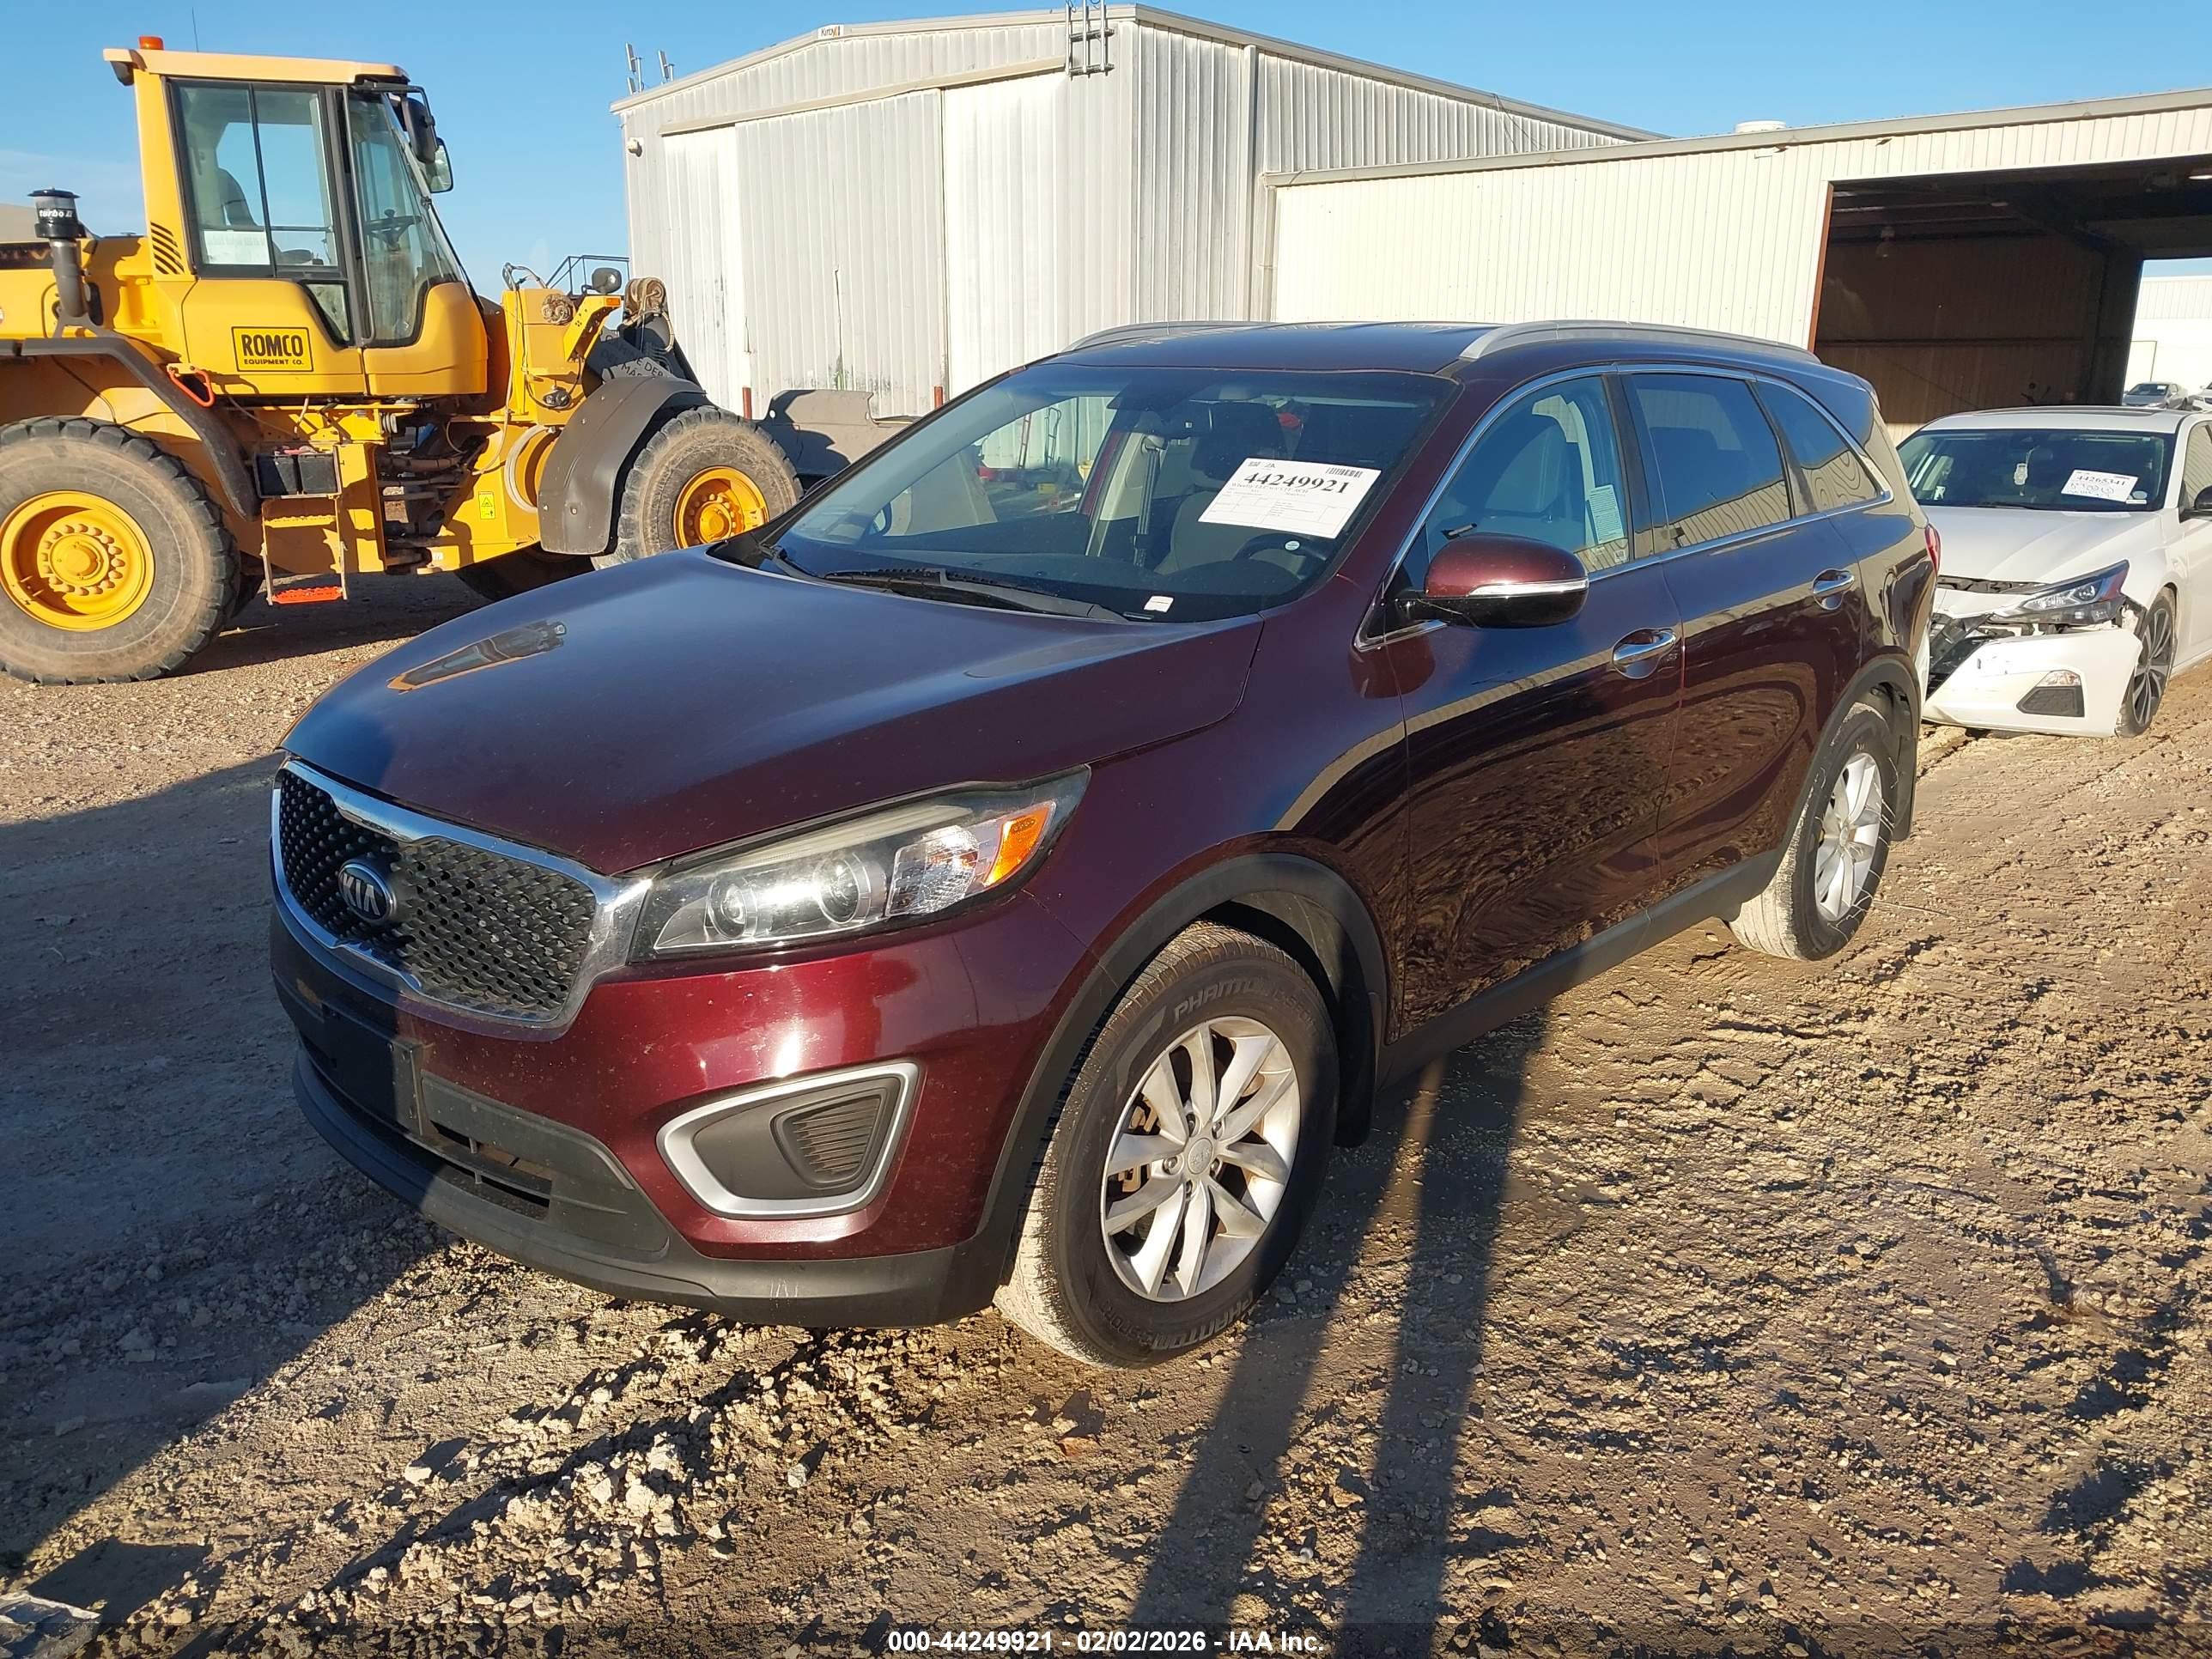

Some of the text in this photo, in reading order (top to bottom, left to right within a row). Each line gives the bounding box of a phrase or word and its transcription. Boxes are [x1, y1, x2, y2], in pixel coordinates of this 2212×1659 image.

[39, 209, 65, 218] turbo
[241, 334, 304, 356] ROMCO
[1244, 472, 1351, 494] 44249921
[343, 872, 381, 916] KIA
